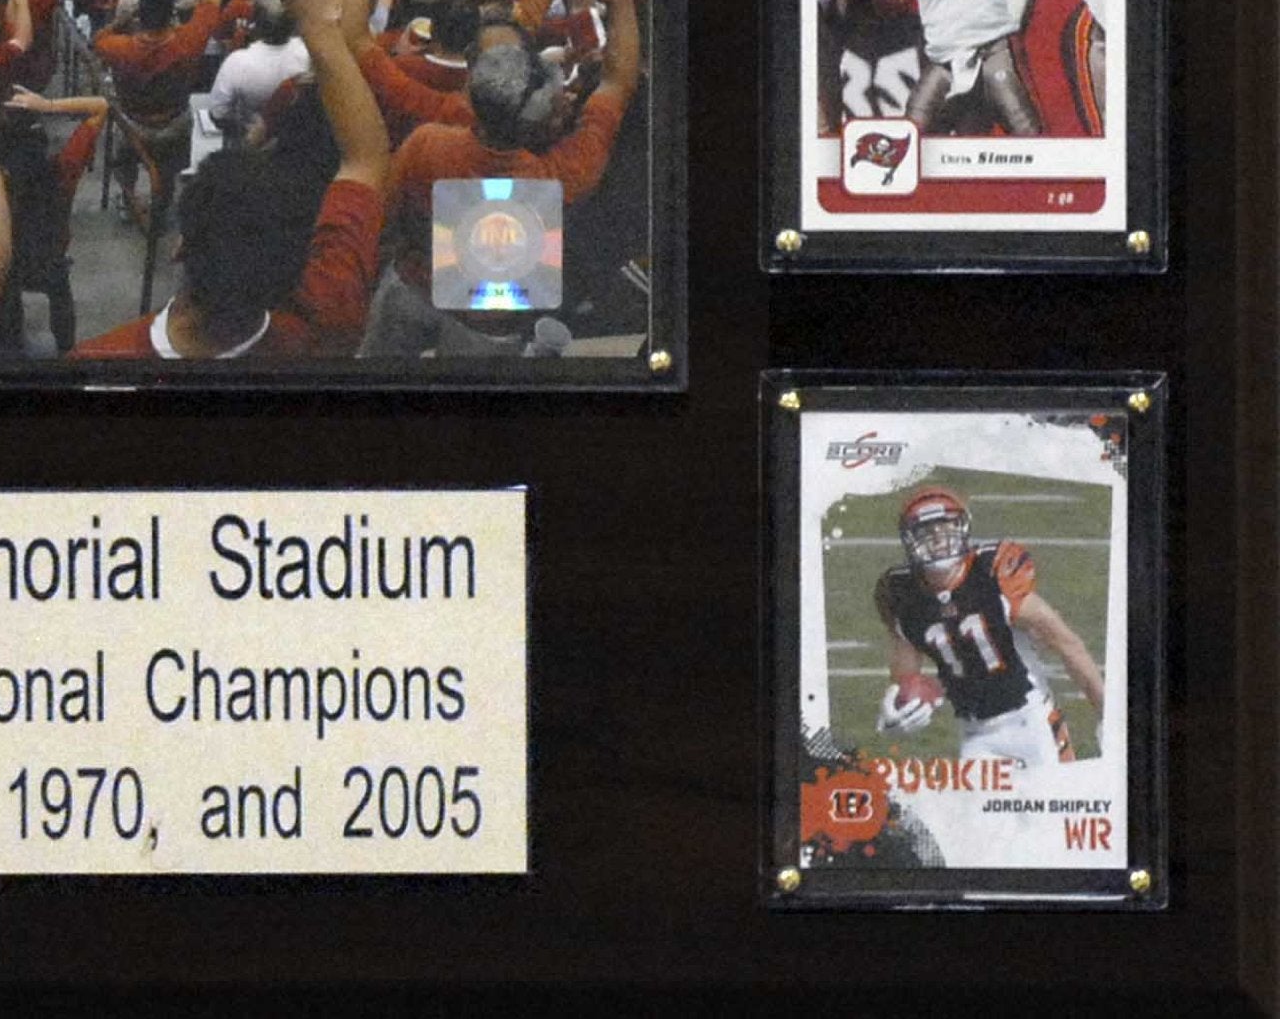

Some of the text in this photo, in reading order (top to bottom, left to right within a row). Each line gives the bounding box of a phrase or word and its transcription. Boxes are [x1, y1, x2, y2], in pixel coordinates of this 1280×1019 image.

[977, 151, 1034, 165] Simms
[209, 514, 475, 601] Stadium
[925, 612, 1005, 677] 11
[145, 648, 465, 740] Champions
[9, 766, 158, 850] 1970,
[200, 766, 302, 840] and
[343, 766, 481, 839] 2005
[982, 799, 1112, 813] JORDAN SHIPLEY
[1064, 817, 1112, 850] WR
